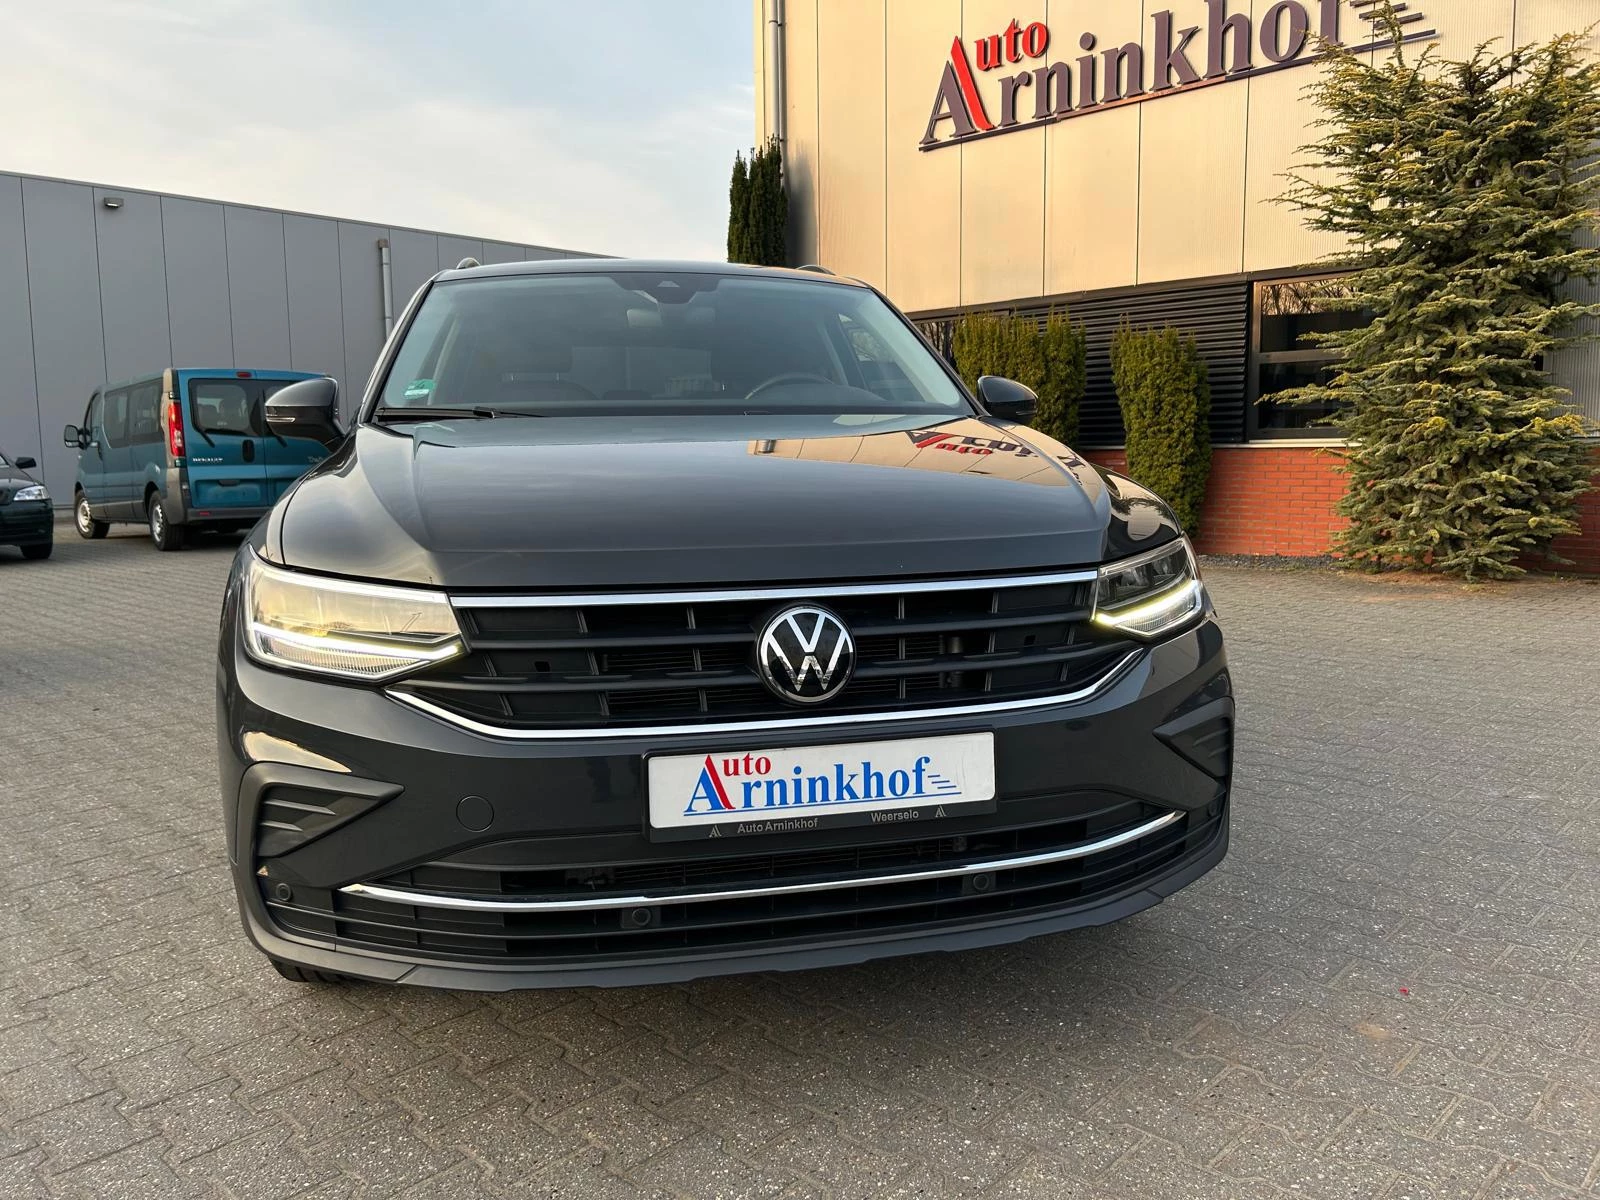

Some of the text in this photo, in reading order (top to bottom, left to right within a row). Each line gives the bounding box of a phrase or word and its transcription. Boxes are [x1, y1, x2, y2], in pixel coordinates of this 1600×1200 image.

[684, 756, 931, 813] Arninkhof
[871, 809, 919, 822] Weerselo
[737, 818, 818, 834] Auto Arninkhof
